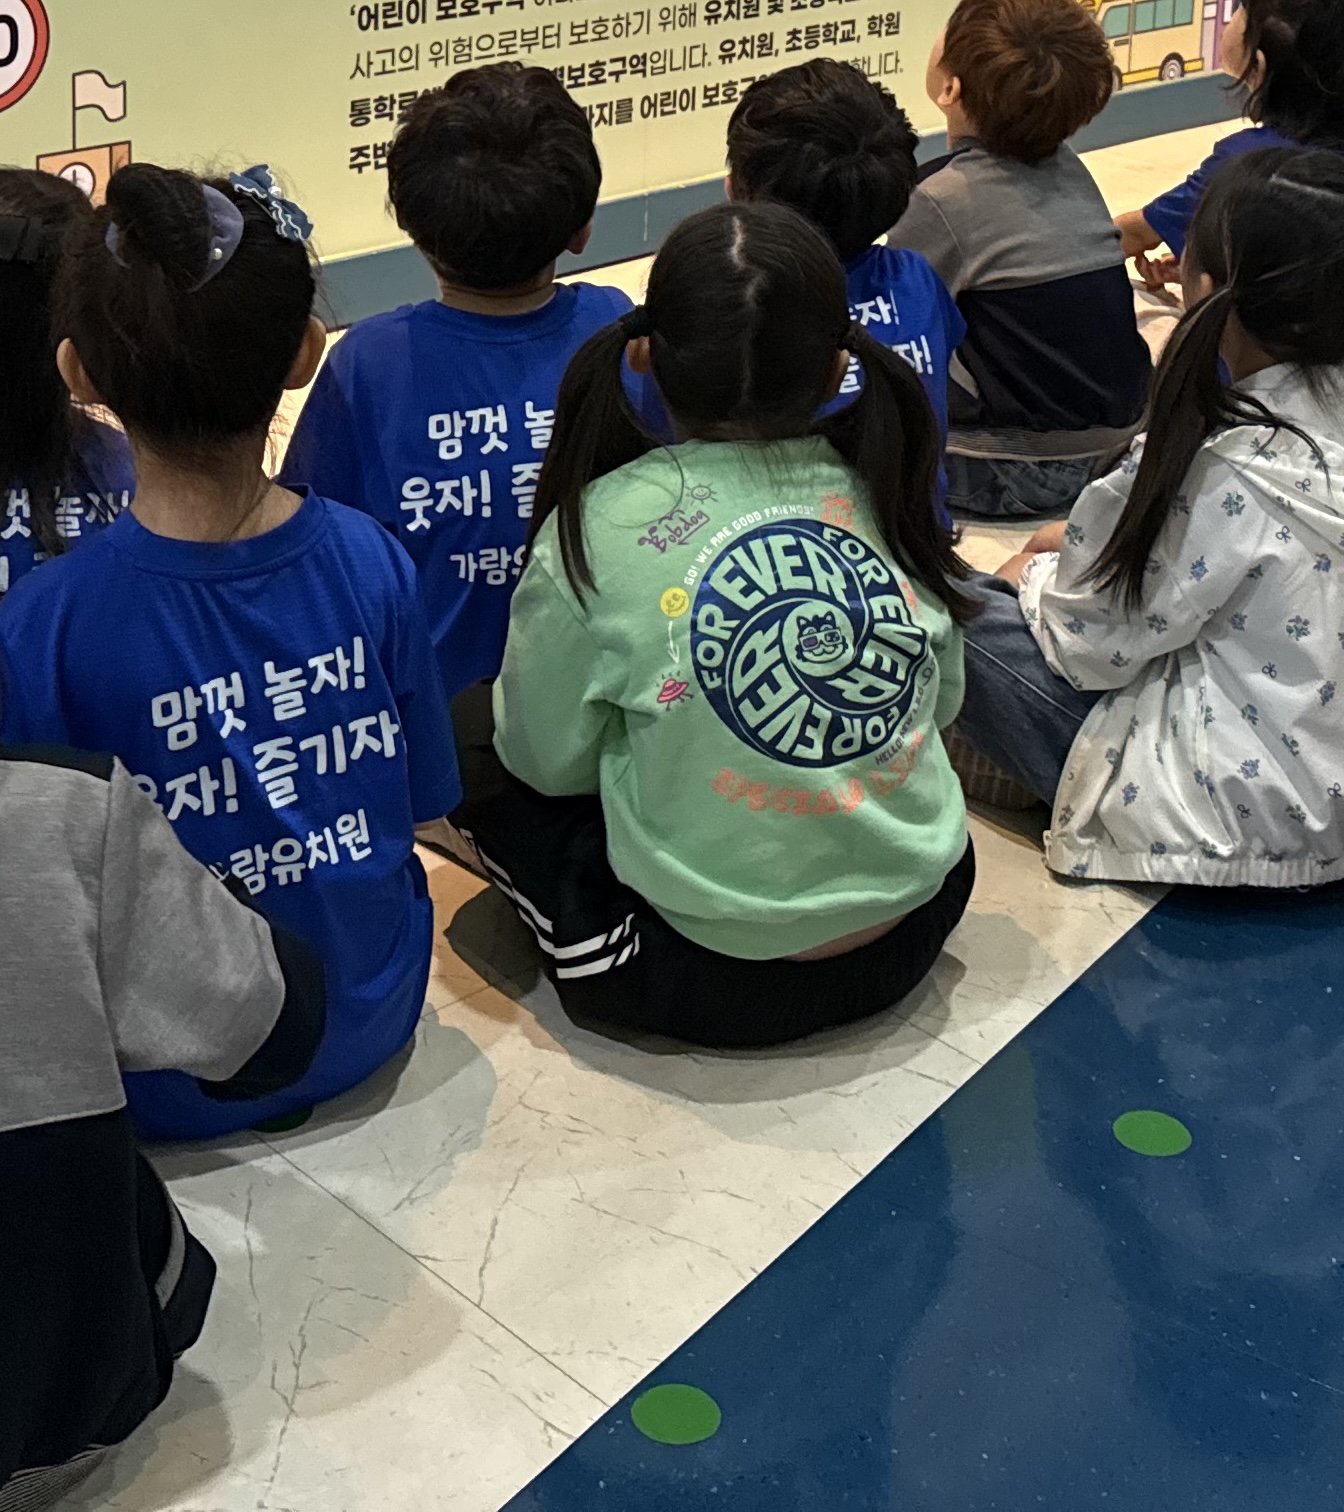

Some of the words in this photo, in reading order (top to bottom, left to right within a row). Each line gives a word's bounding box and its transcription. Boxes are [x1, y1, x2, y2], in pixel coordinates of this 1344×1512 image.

[349, 43, 420, 80] 사고의
[428, 22, 562, 68] 위험으로부터
[568, 8, 651, 46] 보호하기
[657, 1, 697, 33] 위해
[718, 31, 779, 65] 유치원,
[785, 18, 861, 54] 초등학교,
[867, 11, 901, 38] 학원
[640, 86, 696, 119] 어린이
[428, 404, 509, 461] 맘껏
[524, 400, 556, 449] 놀
[399, 469, 492, 532] 웃자!
[694, 545, 713, 564] WE
[709, 526, 733, 548] ARE
[731, 510, 763, 532] GOOD
[151, 671, 247, 752] 맘껏
[264, 636, 366, 721] 놀자!
